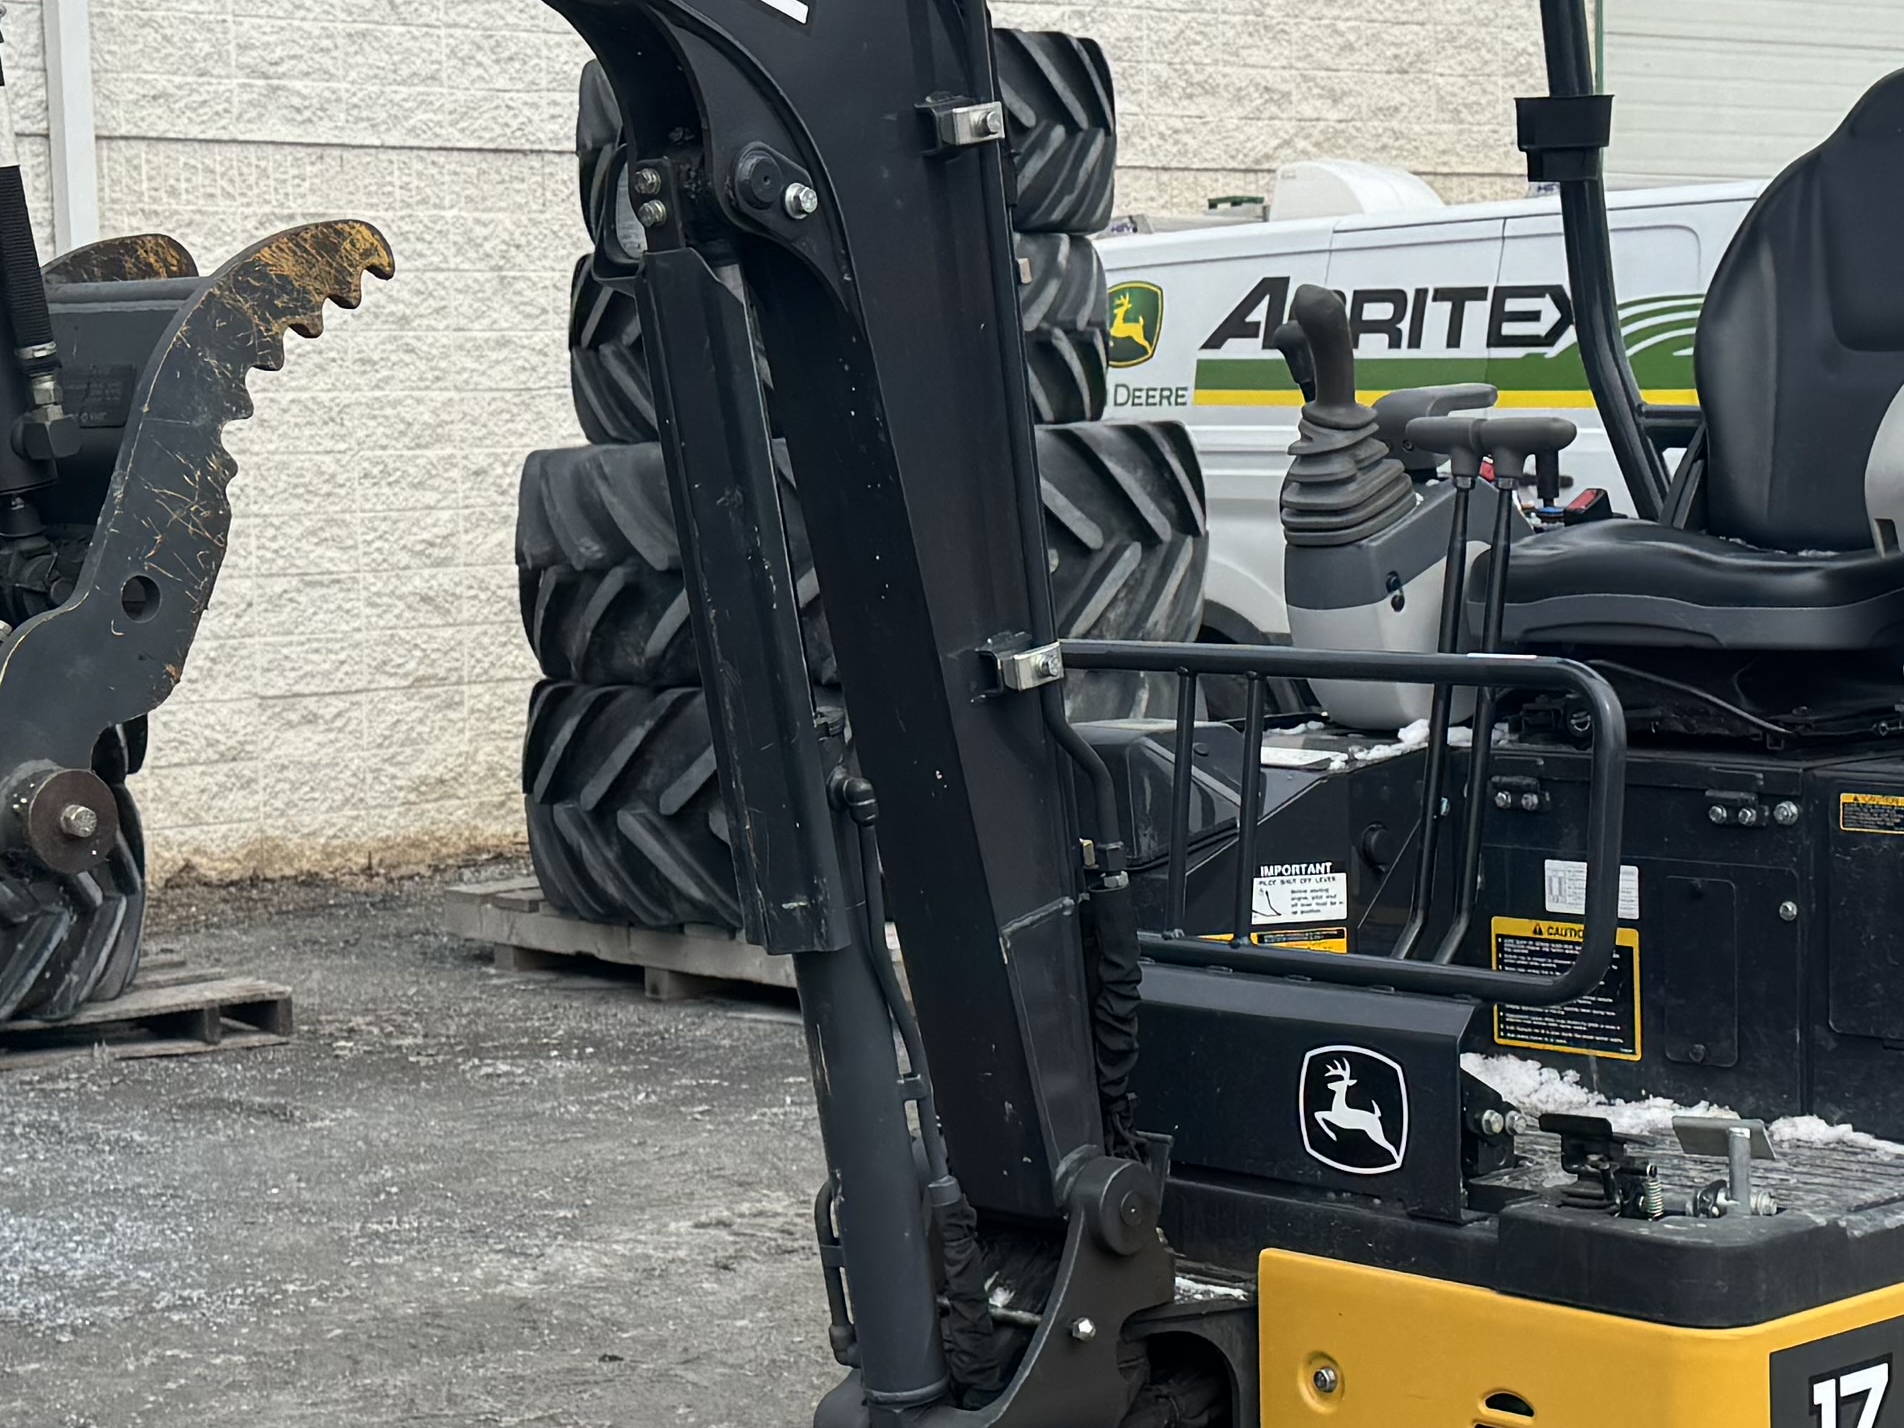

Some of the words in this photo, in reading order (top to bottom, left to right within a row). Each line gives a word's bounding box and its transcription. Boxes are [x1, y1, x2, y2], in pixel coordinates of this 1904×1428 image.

[1113, 383, 1188, 407] DEERE
[1260, 862, 1332, 876] IMPORTANT
[1547, 925, 1585, 939] CAUTIO
